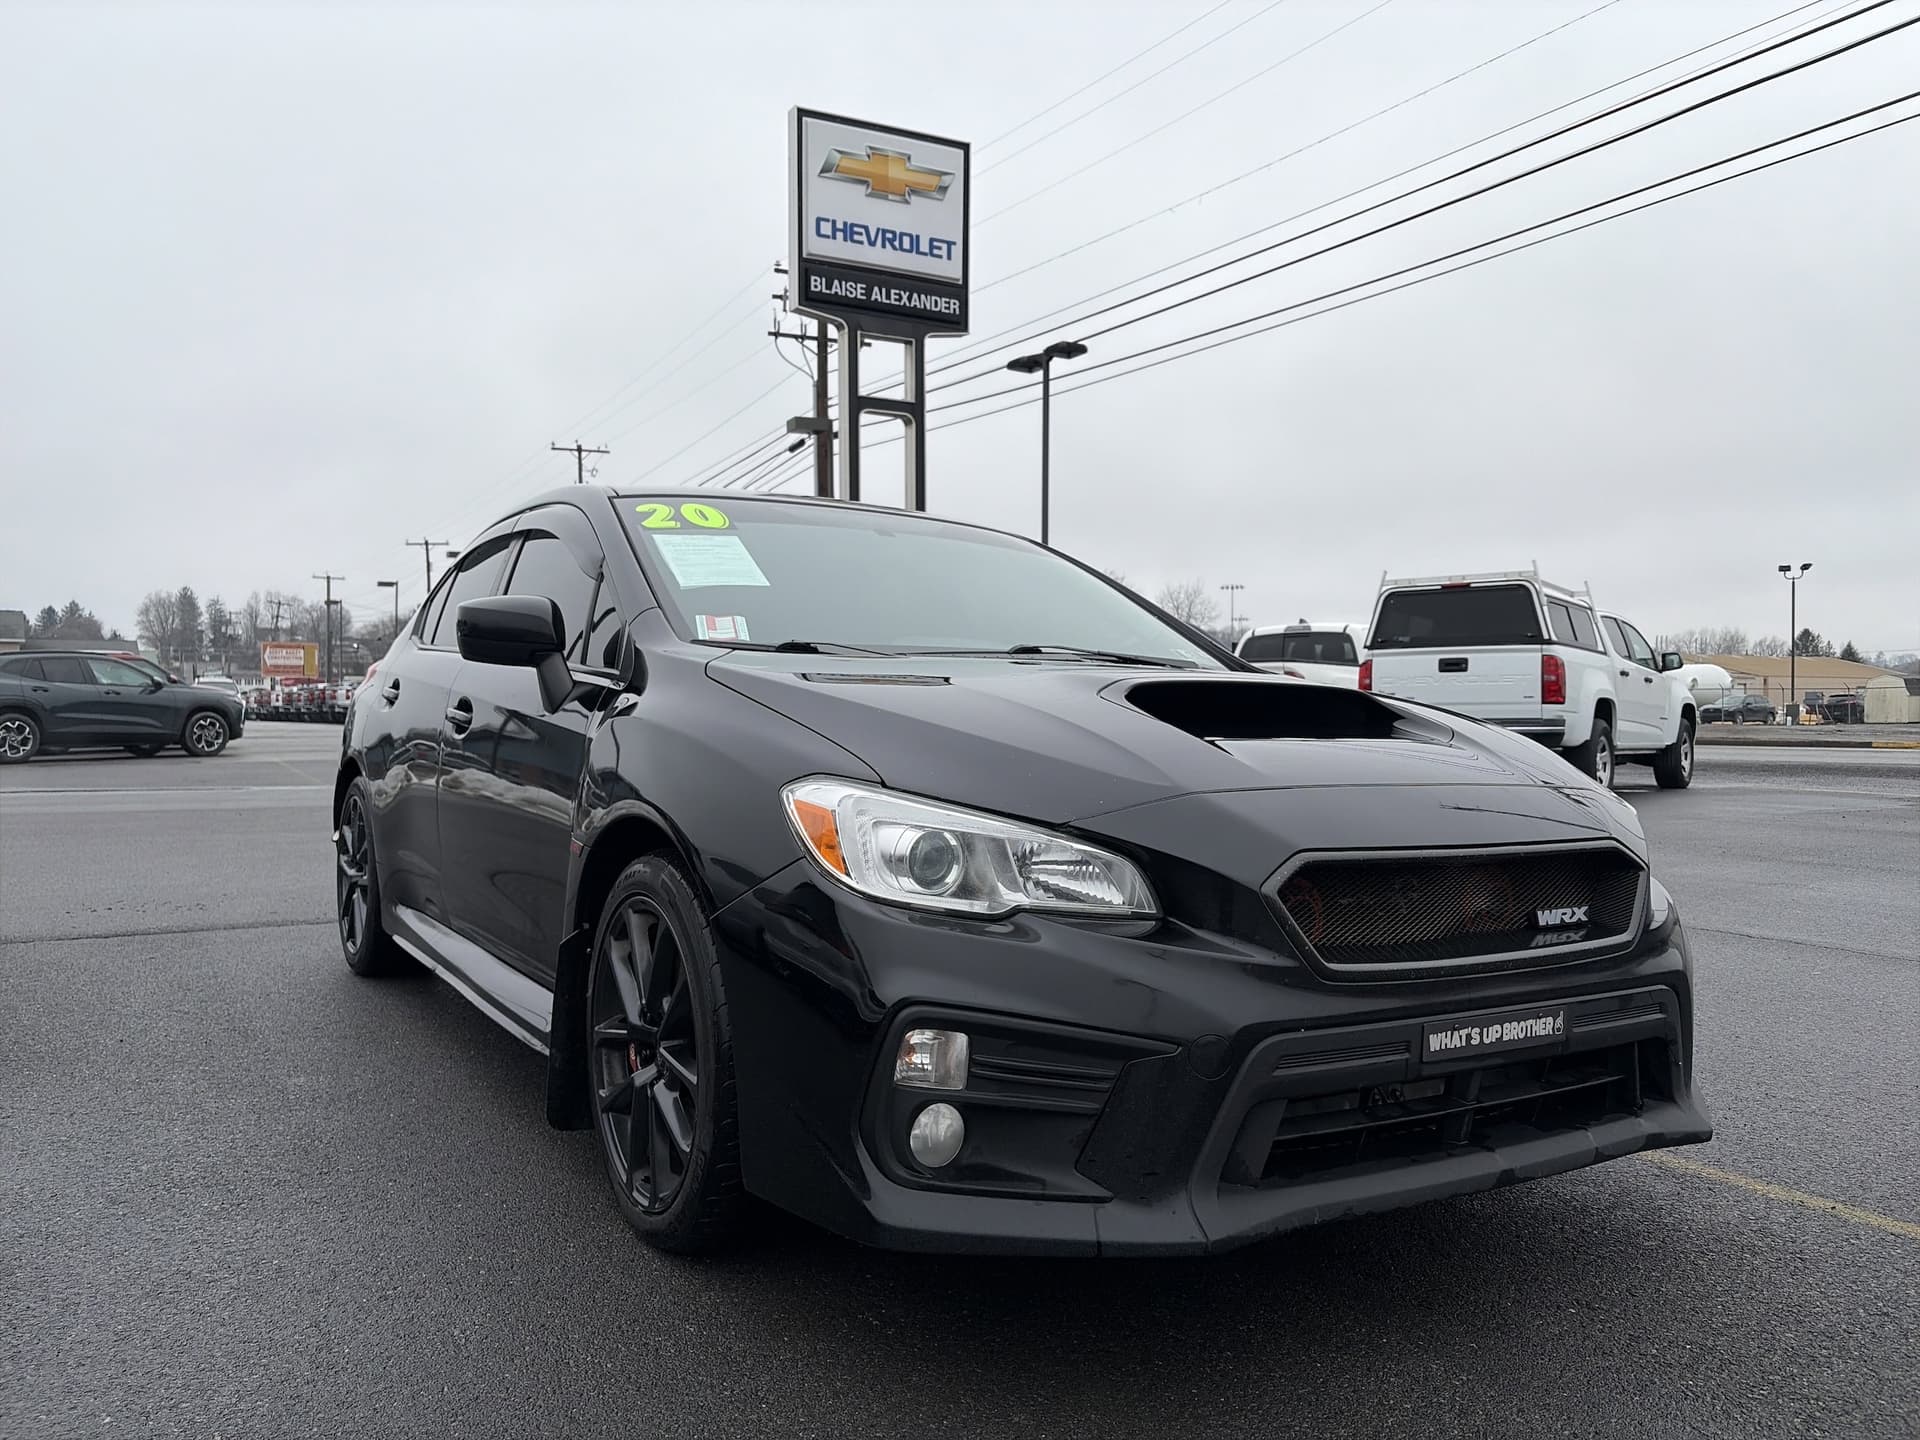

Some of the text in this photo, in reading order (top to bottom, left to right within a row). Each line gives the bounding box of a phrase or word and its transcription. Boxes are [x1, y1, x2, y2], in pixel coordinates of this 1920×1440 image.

[815, 216, 957, 261] CHEVROLET
[810, 275, 960, 315] BLAISE ALEXANDER
[635, 503, 730, 529] 20
[1536, 905, 1589, 927] WRX
[1429, 1017, 1554, 1052] WHAT'S UP BROTHER
